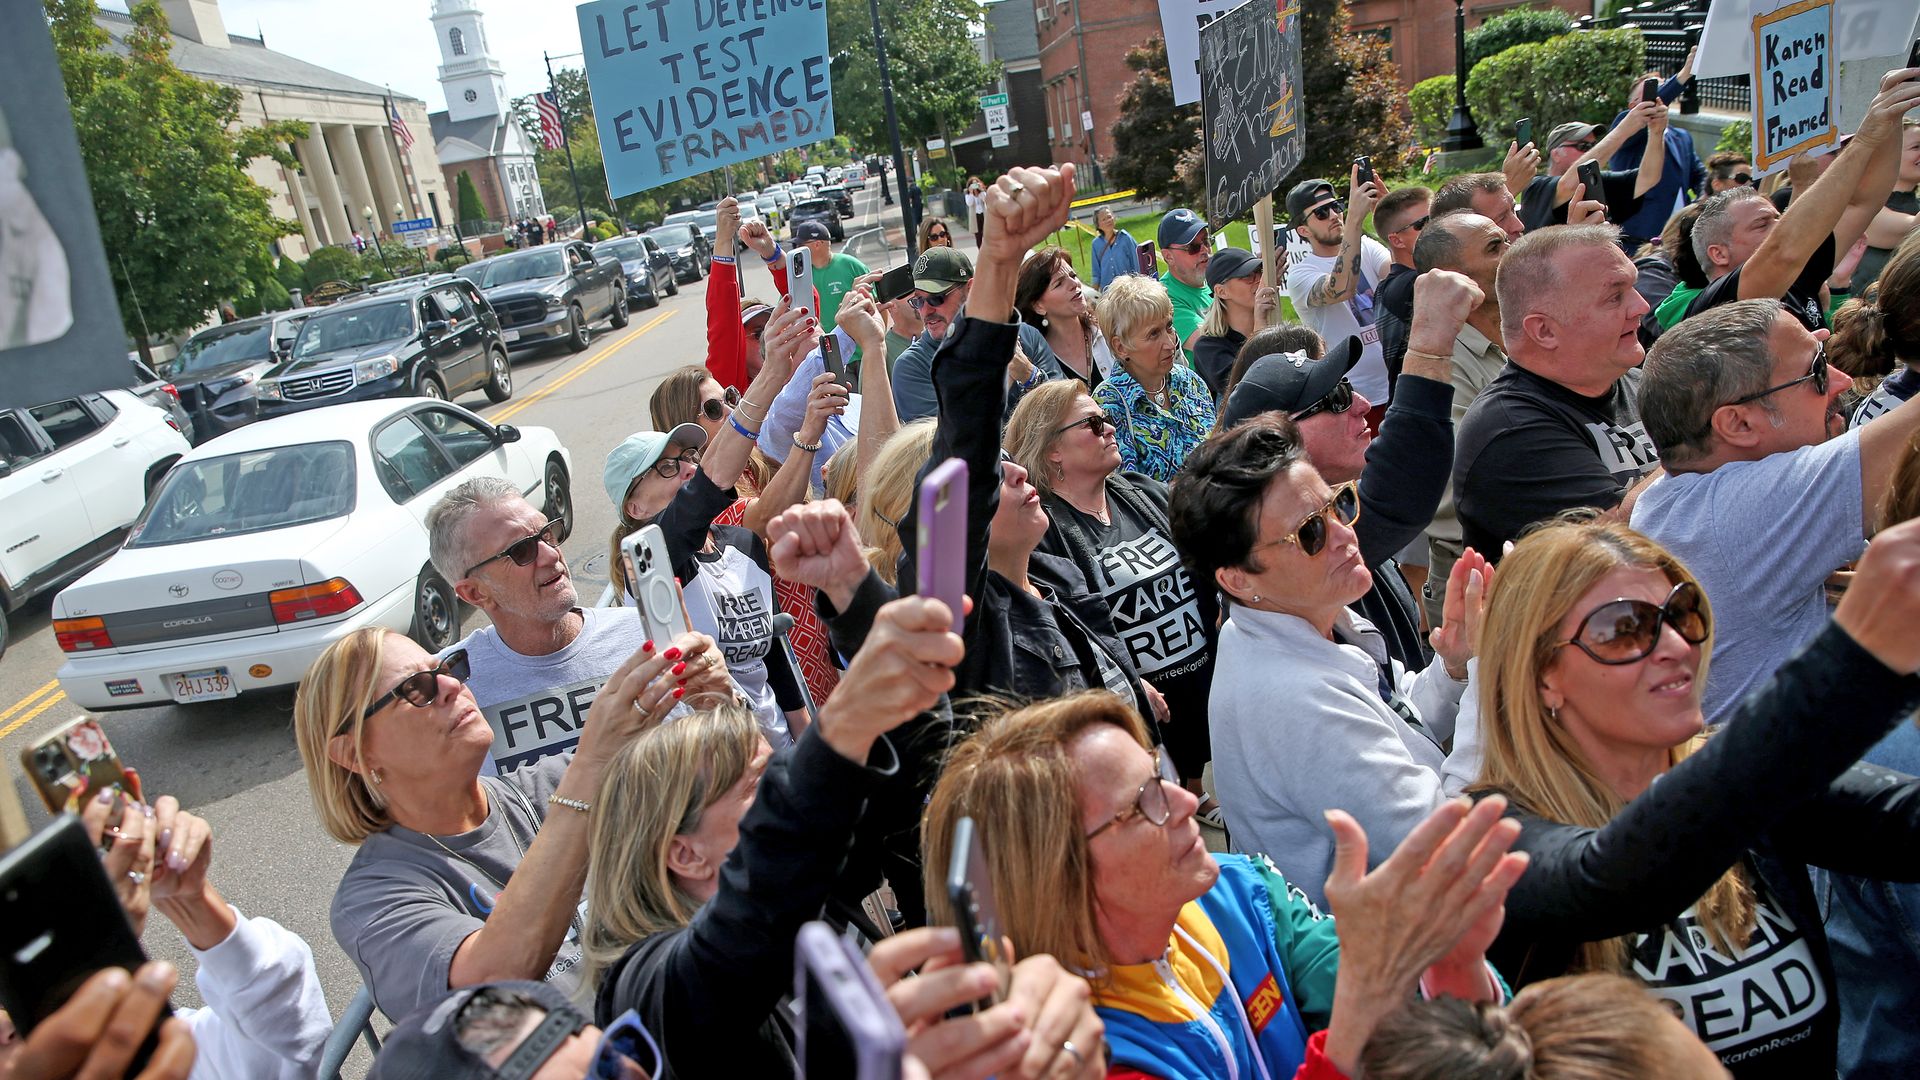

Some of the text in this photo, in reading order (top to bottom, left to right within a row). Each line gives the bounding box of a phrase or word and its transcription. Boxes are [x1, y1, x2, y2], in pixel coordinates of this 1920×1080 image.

[596, 0, 670, 58] LET
[660, 27, 765, 83] TEST
[1765, 32, 1825, 70] Karen
[614, 55, 828, 152] EVIDENCE
[1772, 54, 1823, 106] Read
[655, 102, 829, 175] FRAMED!
[988, 109, 1003, 117] ONE
[990, 116, 1004, 124] WAY
[1767, 97, 1829, 153] Framed
[1601, 428, 1661, 466] FRE
[1098, 530, 1176, 587] FRE
[163, 616, 212, 628] COROLLA
[1110, 567, 1195, 625] KARE
[720, 615, 772, 640] KAREN
[725, 641, 768, 663] READ
[1124, 610, 1206, 669] REA
[499, 684, 604, 748] FRE
[1660, 958, 1815, 1043] EAD
